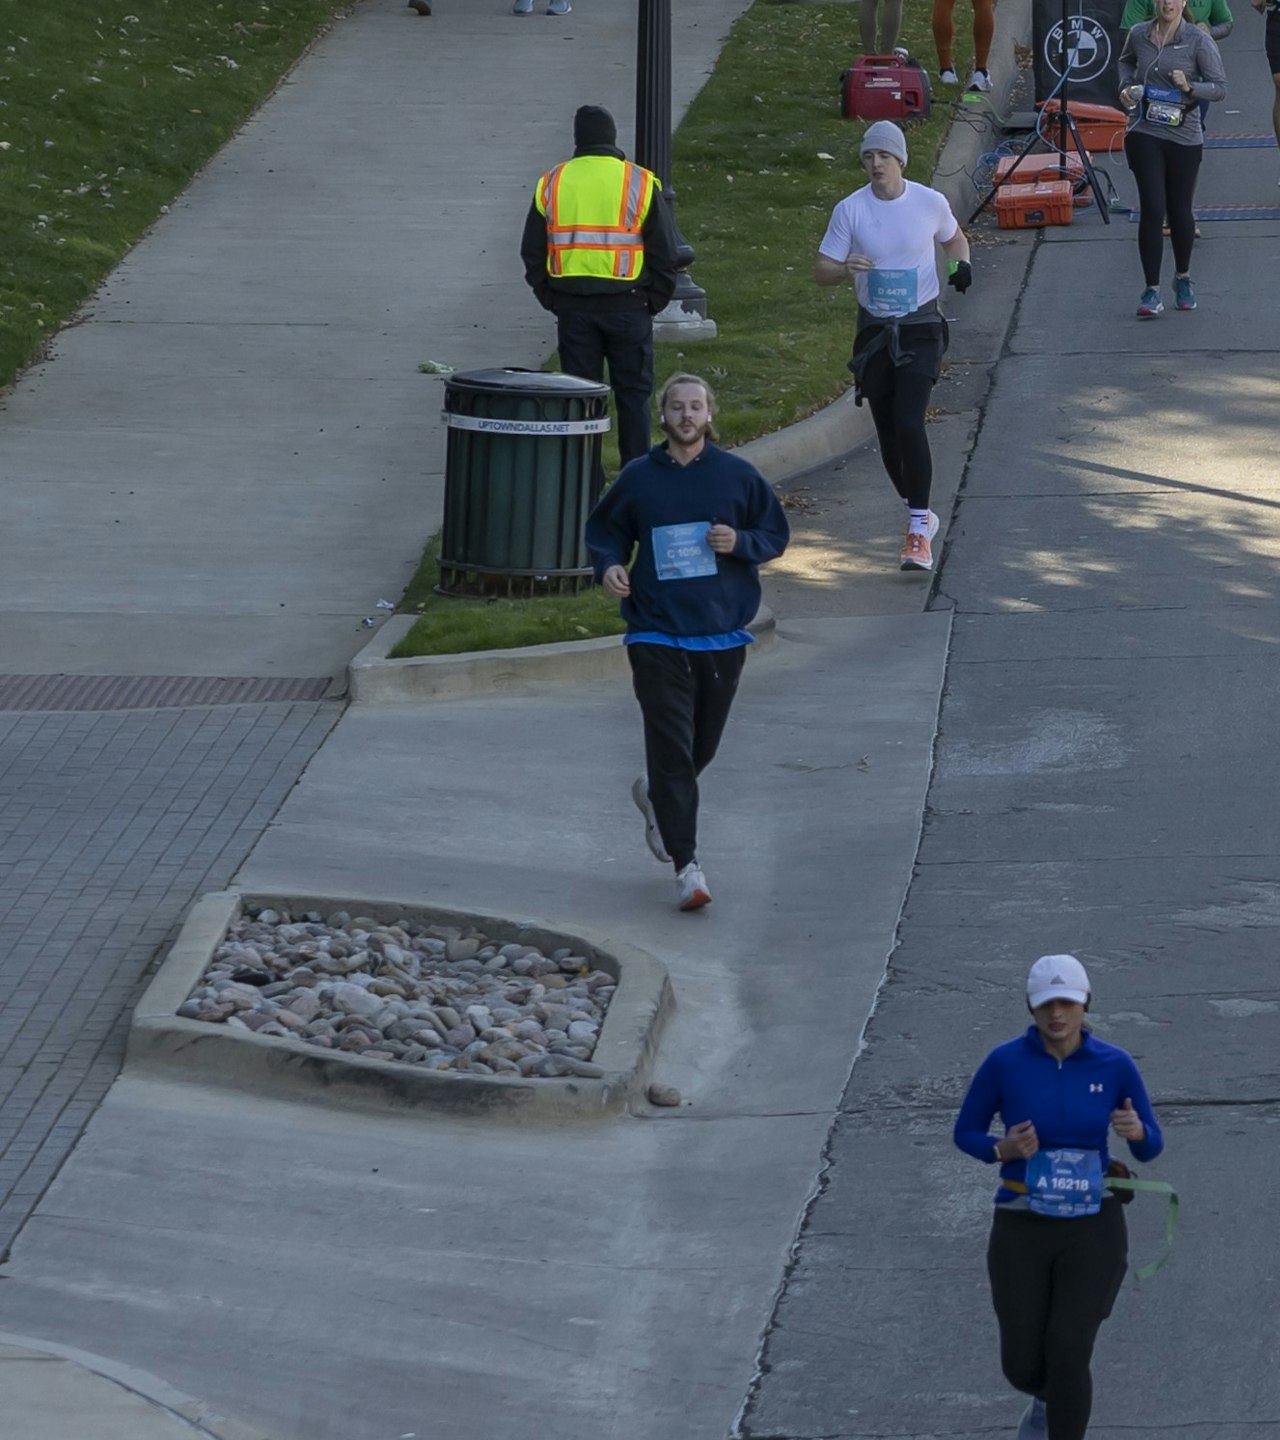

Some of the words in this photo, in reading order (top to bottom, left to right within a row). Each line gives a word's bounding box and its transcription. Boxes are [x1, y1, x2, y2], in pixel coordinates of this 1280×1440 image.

[1052, 20, 1103, 39] BMW
[1036, 1176, 1048, 1188] A
[1051, 1177, 1089, 1191] 16218
